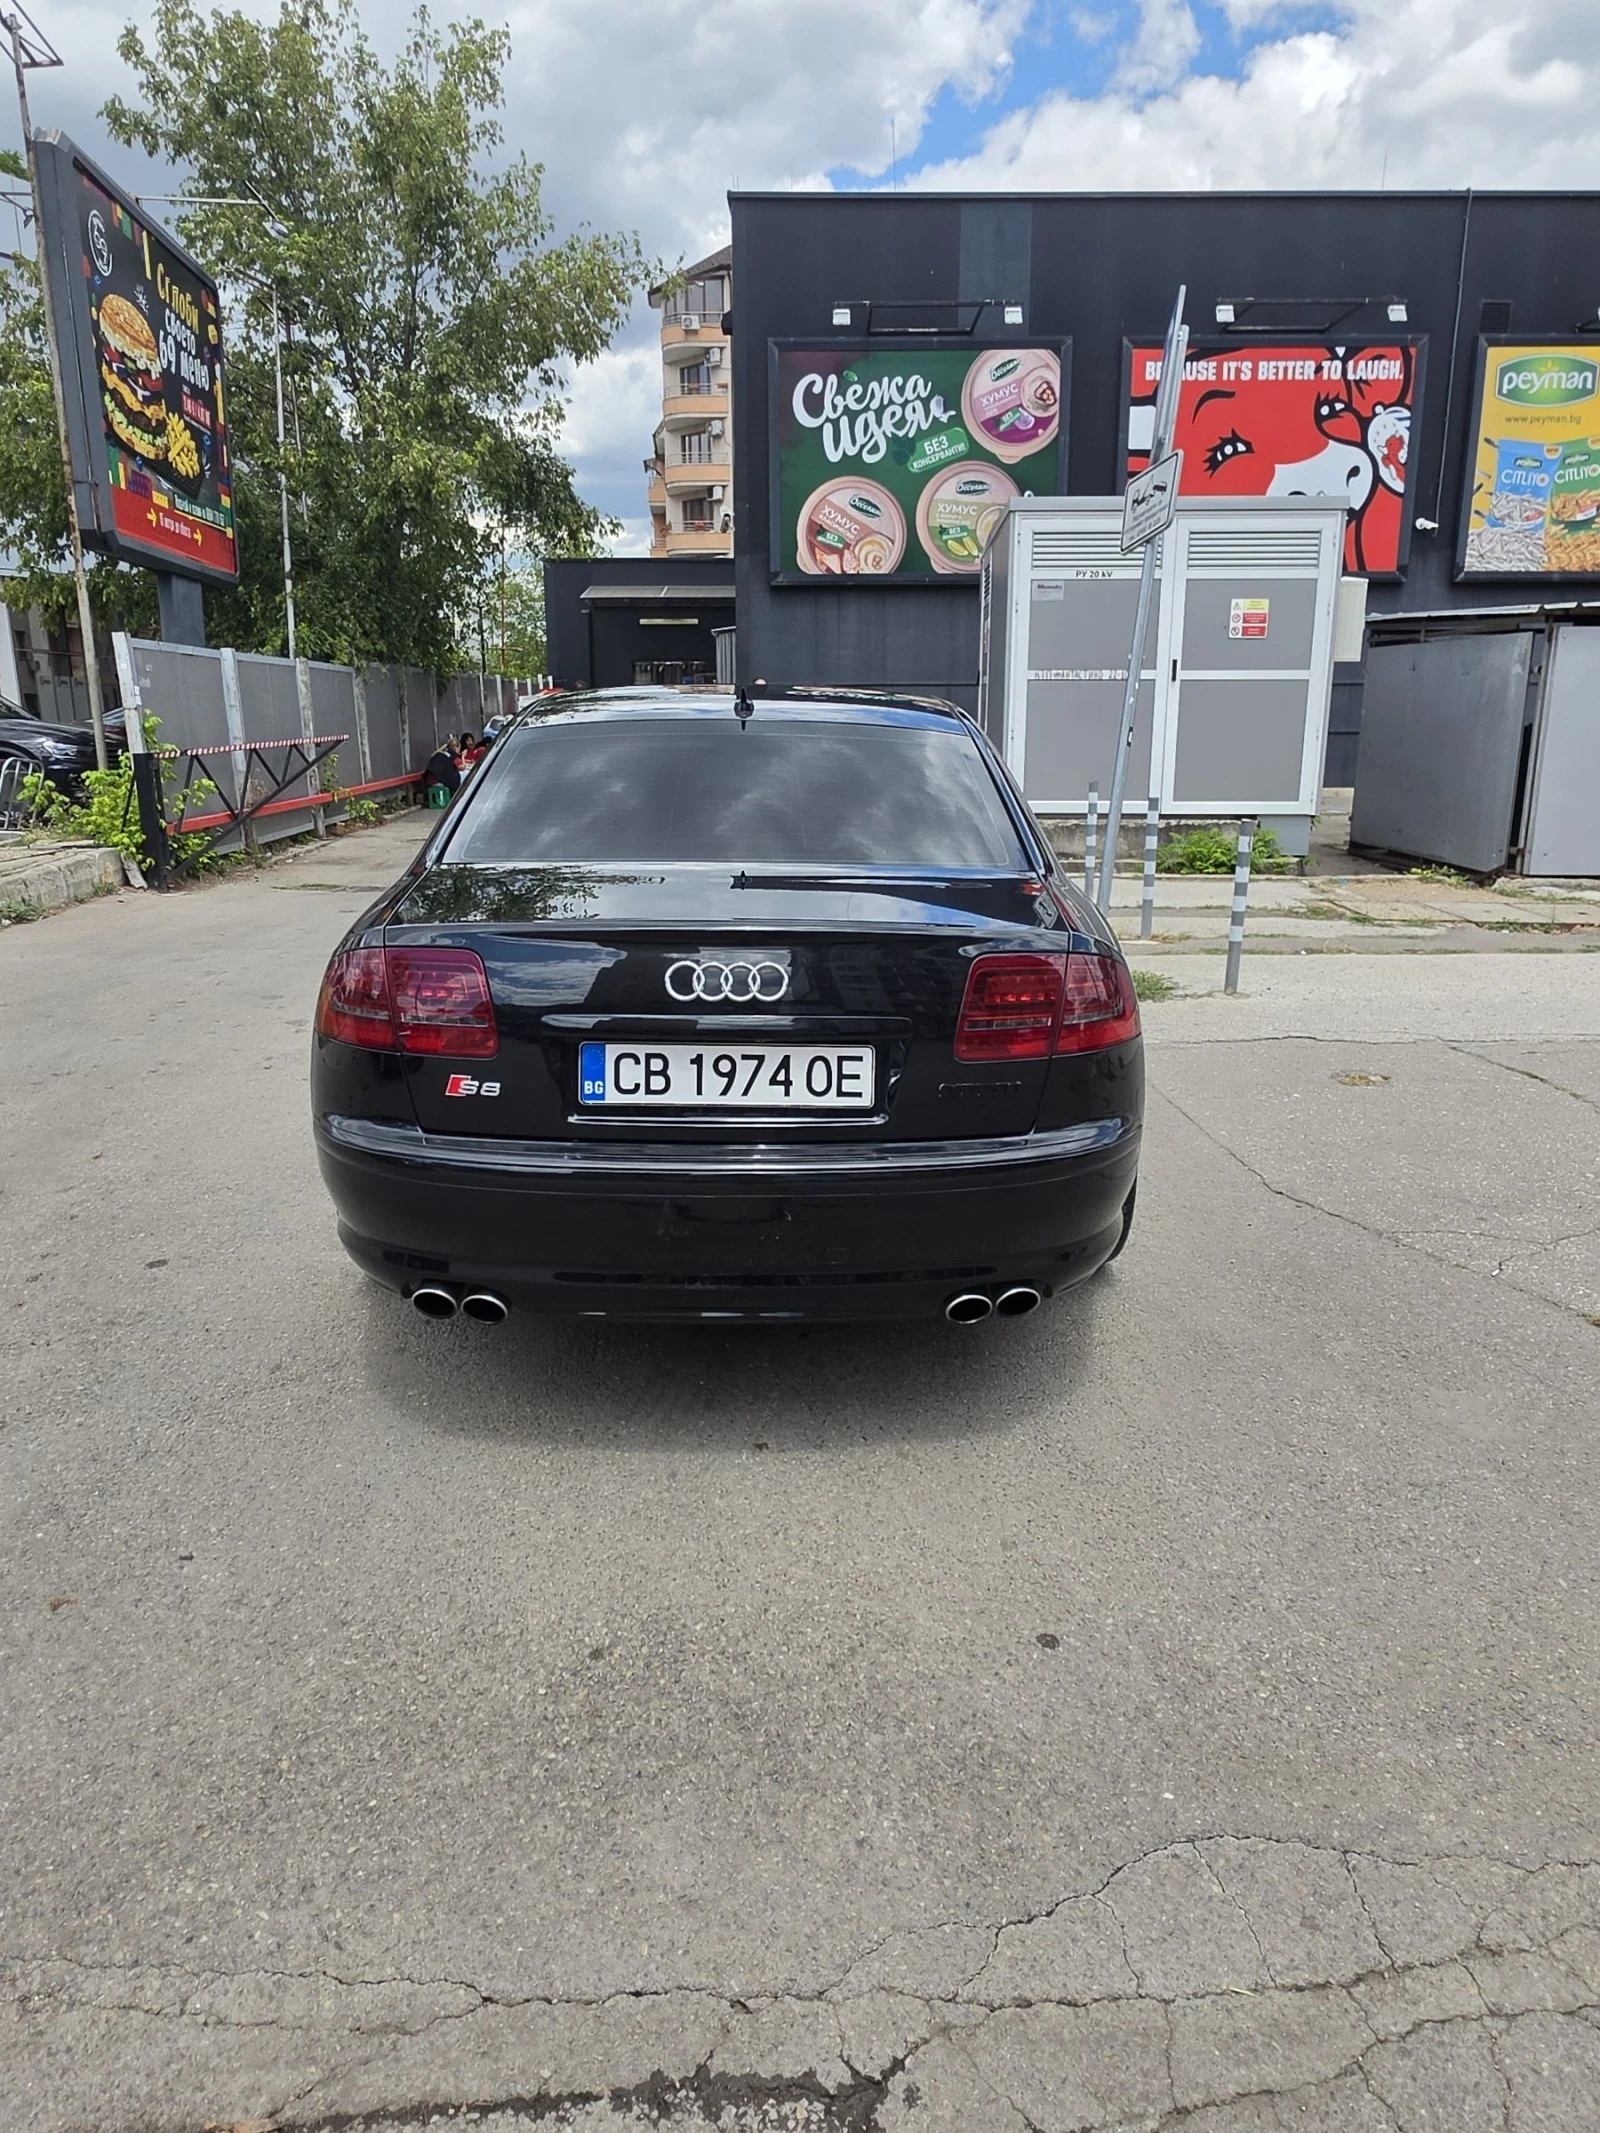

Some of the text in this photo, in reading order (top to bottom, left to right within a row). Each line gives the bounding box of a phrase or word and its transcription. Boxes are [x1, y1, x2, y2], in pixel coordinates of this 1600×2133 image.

[157, 263, 199, 335] Сглоби
[165, 308, 196, 356] своето
[159, 328, 176, 375] 69
[1145, 360, 1404, 381] BEUSE IT'S BETTER TO LAUGH.
[1502, 371, 1594, 394] peyman
[792, 373, 932, 428] Свежа
[981, 383, 1018, 407] ХУМУС
[823, 399, 945, 463] идея
[1505, 414, 1582, 425] www.peyman.bg
[923, 435, 948, 455] БЕЗ
[821, 505, 860, 535] ХУМУС
[938, 503, 978, 516] ХУМУС
[1089, 570, 1100, 578] 20
[584, 1080, 604, 1094] BG
[614, 1052, 671, 1095] CB
[690, 1053, 793, 1097] 1974
[456, 1080, 501, 1097] S8
